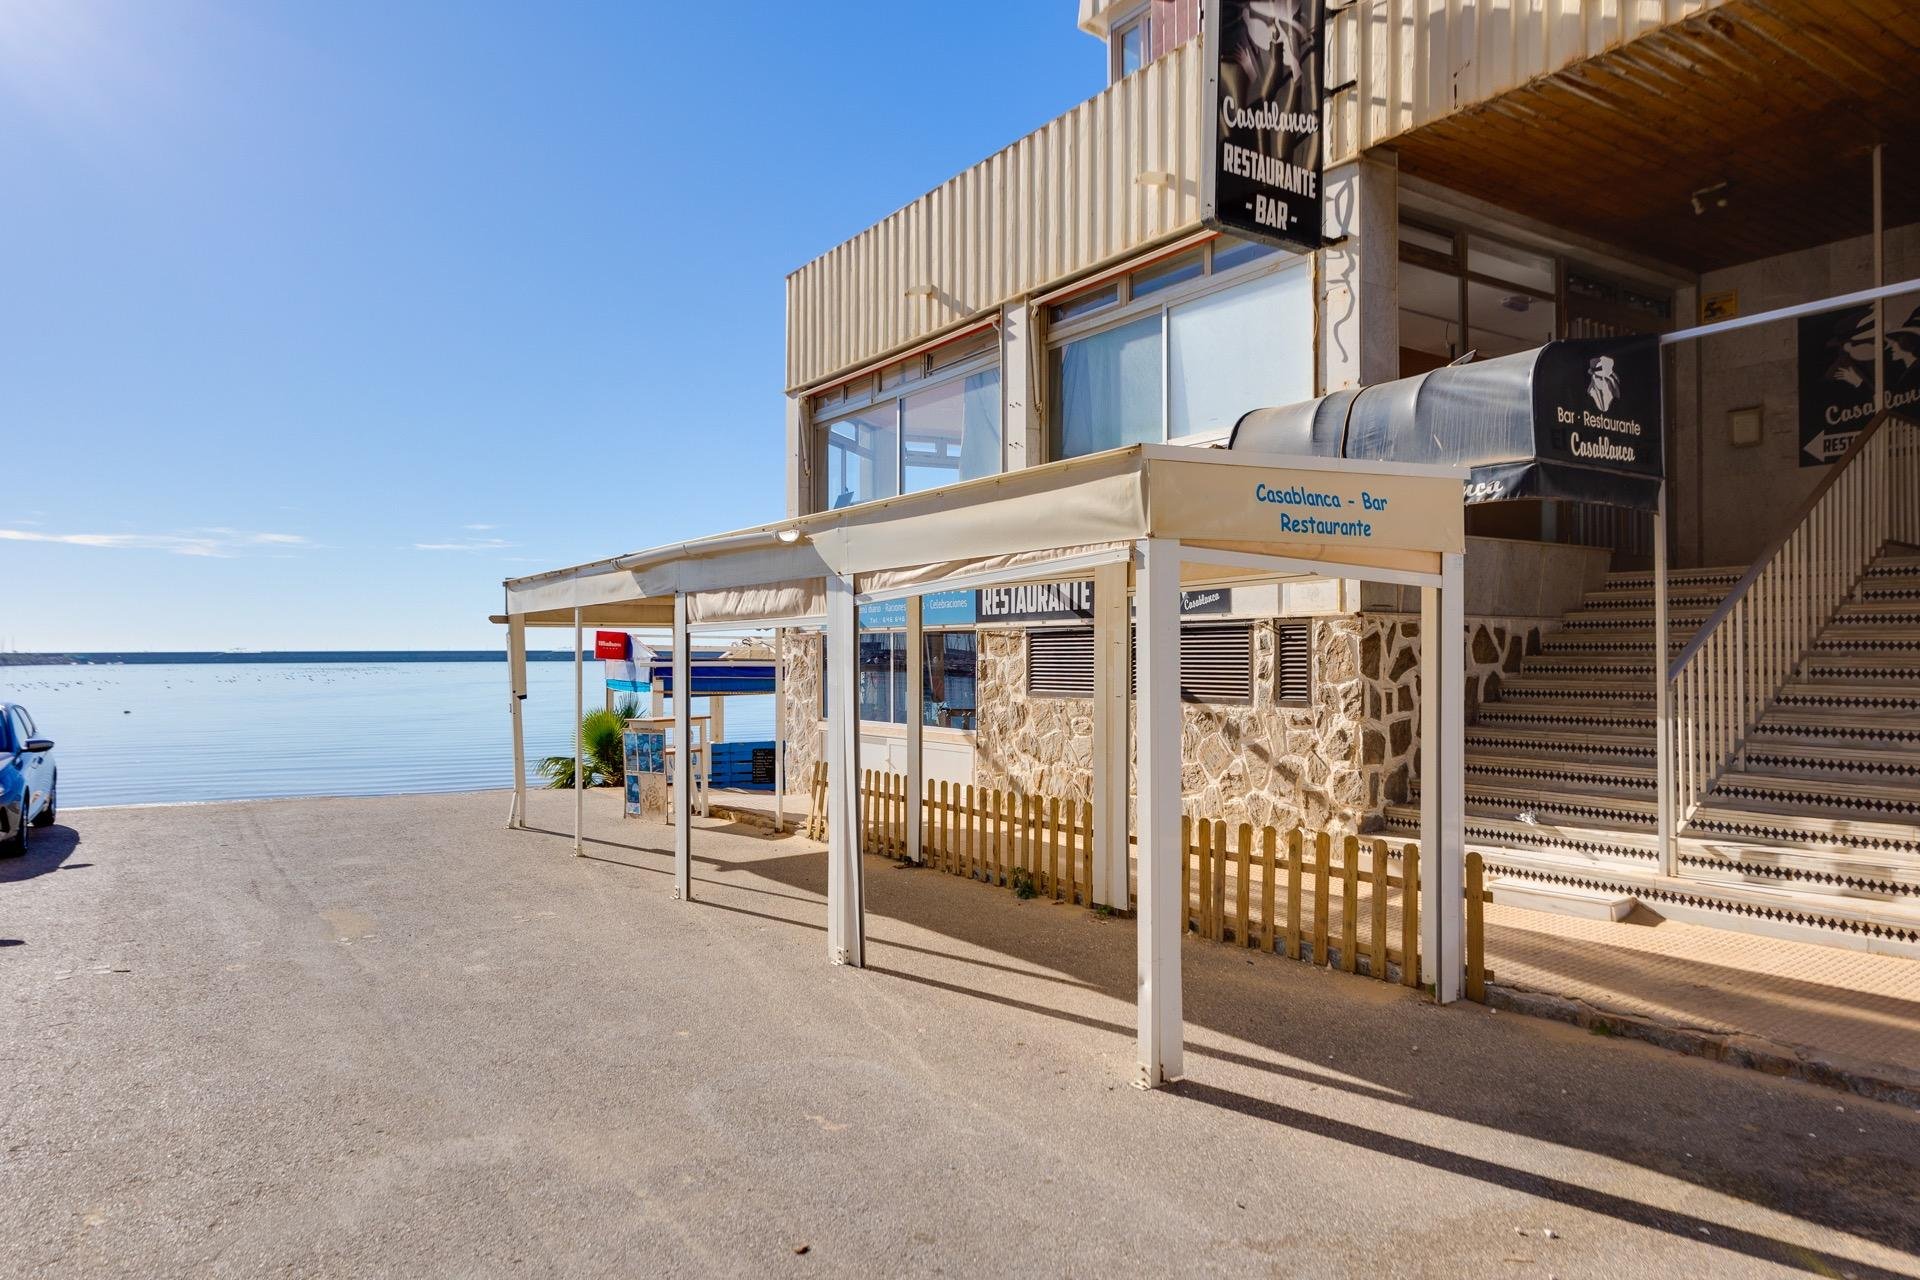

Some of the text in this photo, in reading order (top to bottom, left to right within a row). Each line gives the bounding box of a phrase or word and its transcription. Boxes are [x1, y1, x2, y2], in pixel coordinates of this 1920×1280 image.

[1223, 95, 1319, 134] Casablanca
[1223, 142, 1316, 199] RESTAURANTE
[1557, 406, 1575, 424] Bar
[1583, 410, 1641, 436] Restaurante
[1825, 388, 1920, 425] Casalan
[1570, 432, 1636, 462] Casablanca
[1256, 483, 1341, 508] Casablanca
[1361, 491, 1388, 511] Bar
[1280, 513, 1372, 536] Restaurante
[981, 581, 1091, 615] RESTAURANTE
